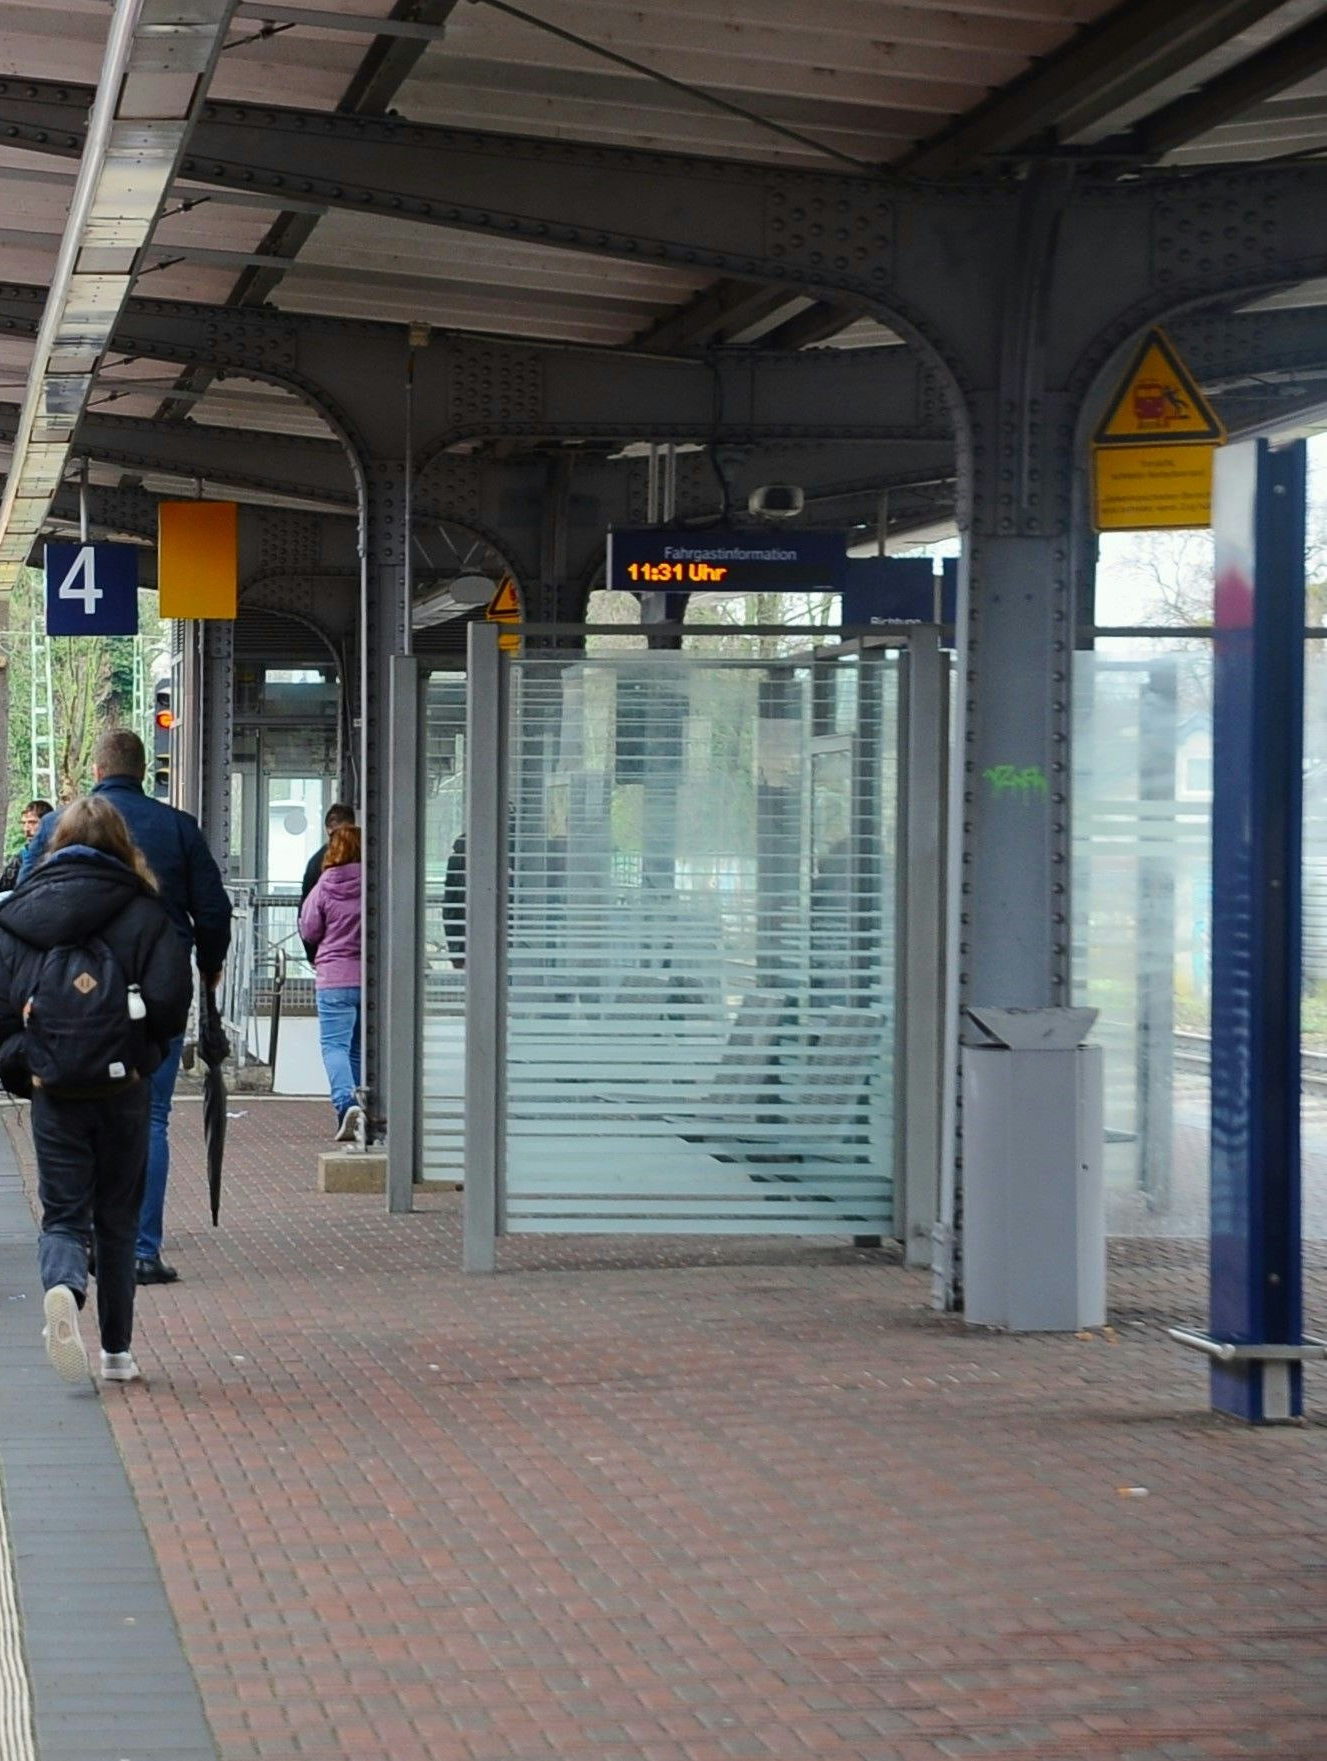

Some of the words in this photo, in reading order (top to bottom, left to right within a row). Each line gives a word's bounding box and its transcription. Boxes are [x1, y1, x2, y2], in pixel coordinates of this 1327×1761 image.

[664, 546, 797, 562] Fahrgastinformation
[59, 547, 103, 614] 4
[628, 563, 683, 581] 11:31
[688, 563, 727, 581] Uhr
